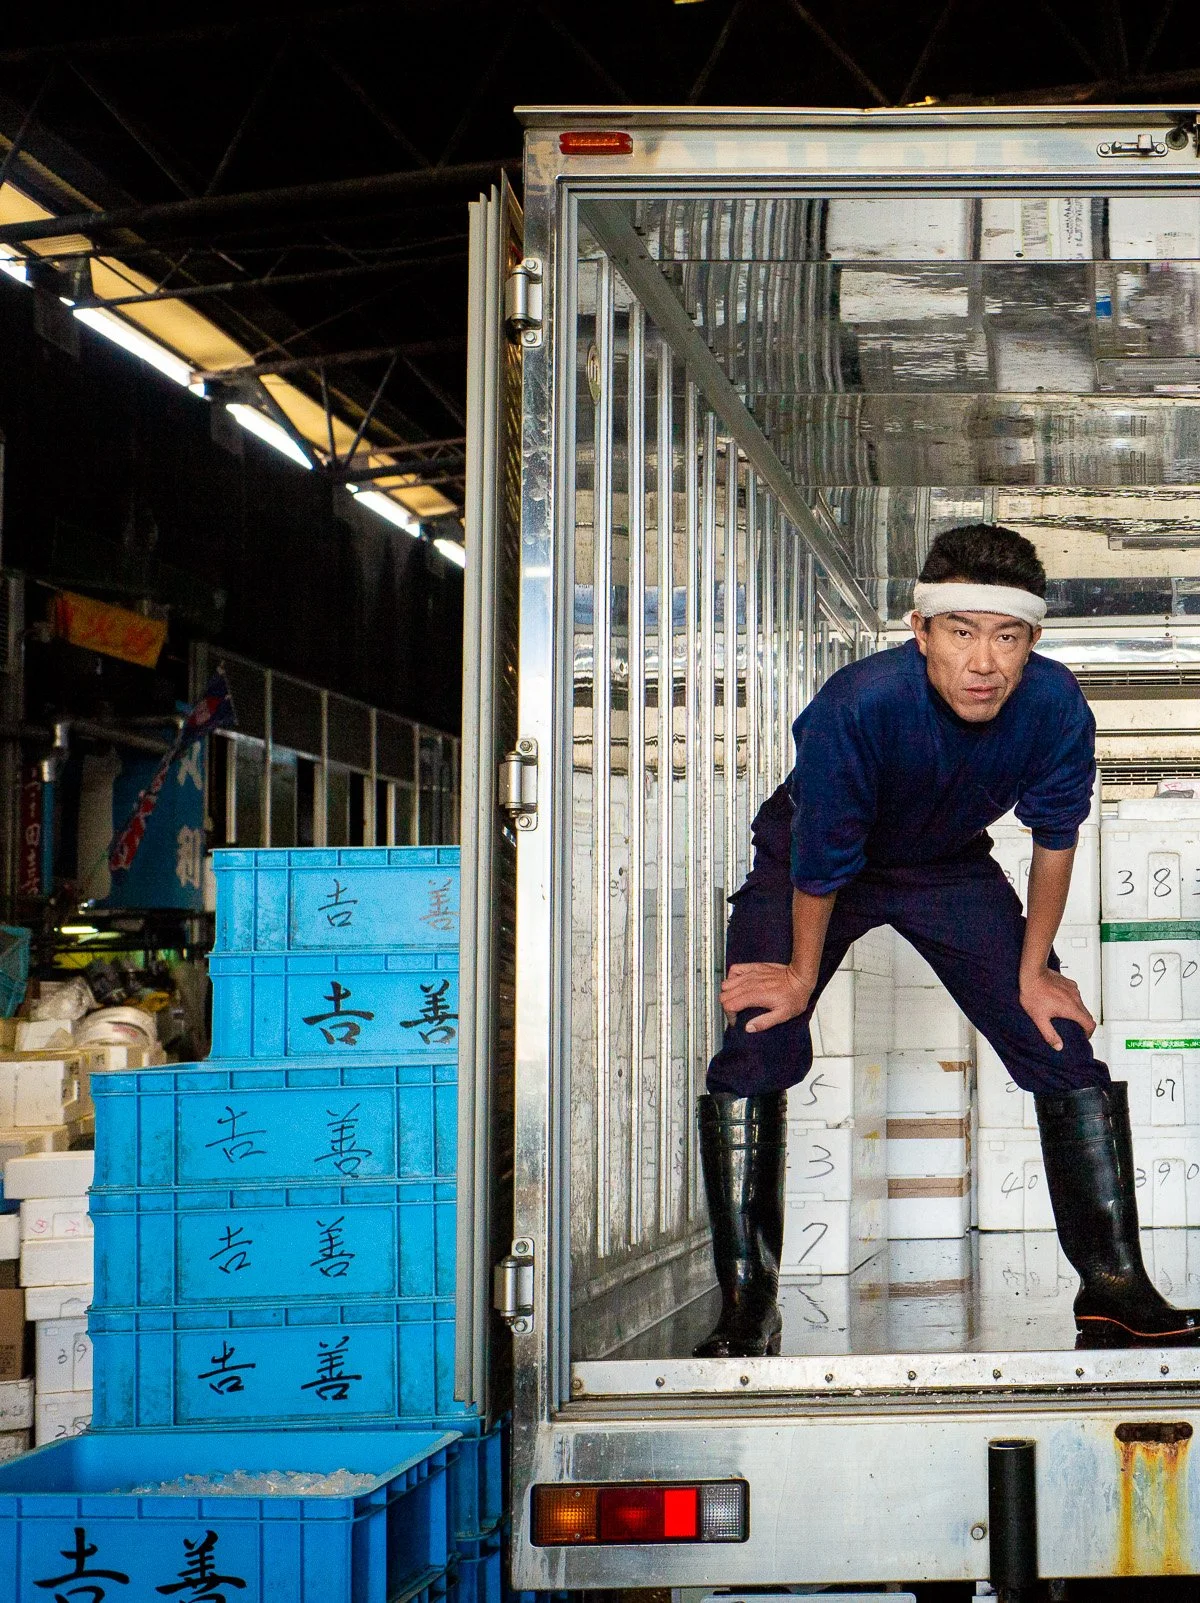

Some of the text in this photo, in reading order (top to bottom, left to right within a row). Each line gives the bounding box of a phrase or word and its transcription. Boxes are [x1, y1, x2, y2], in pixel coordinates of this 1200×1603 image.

[1130, 958, 1198, 988] 390
[1155, 1078, 1176, 1102] 67
[804, 1144, 834, 1179] 3
